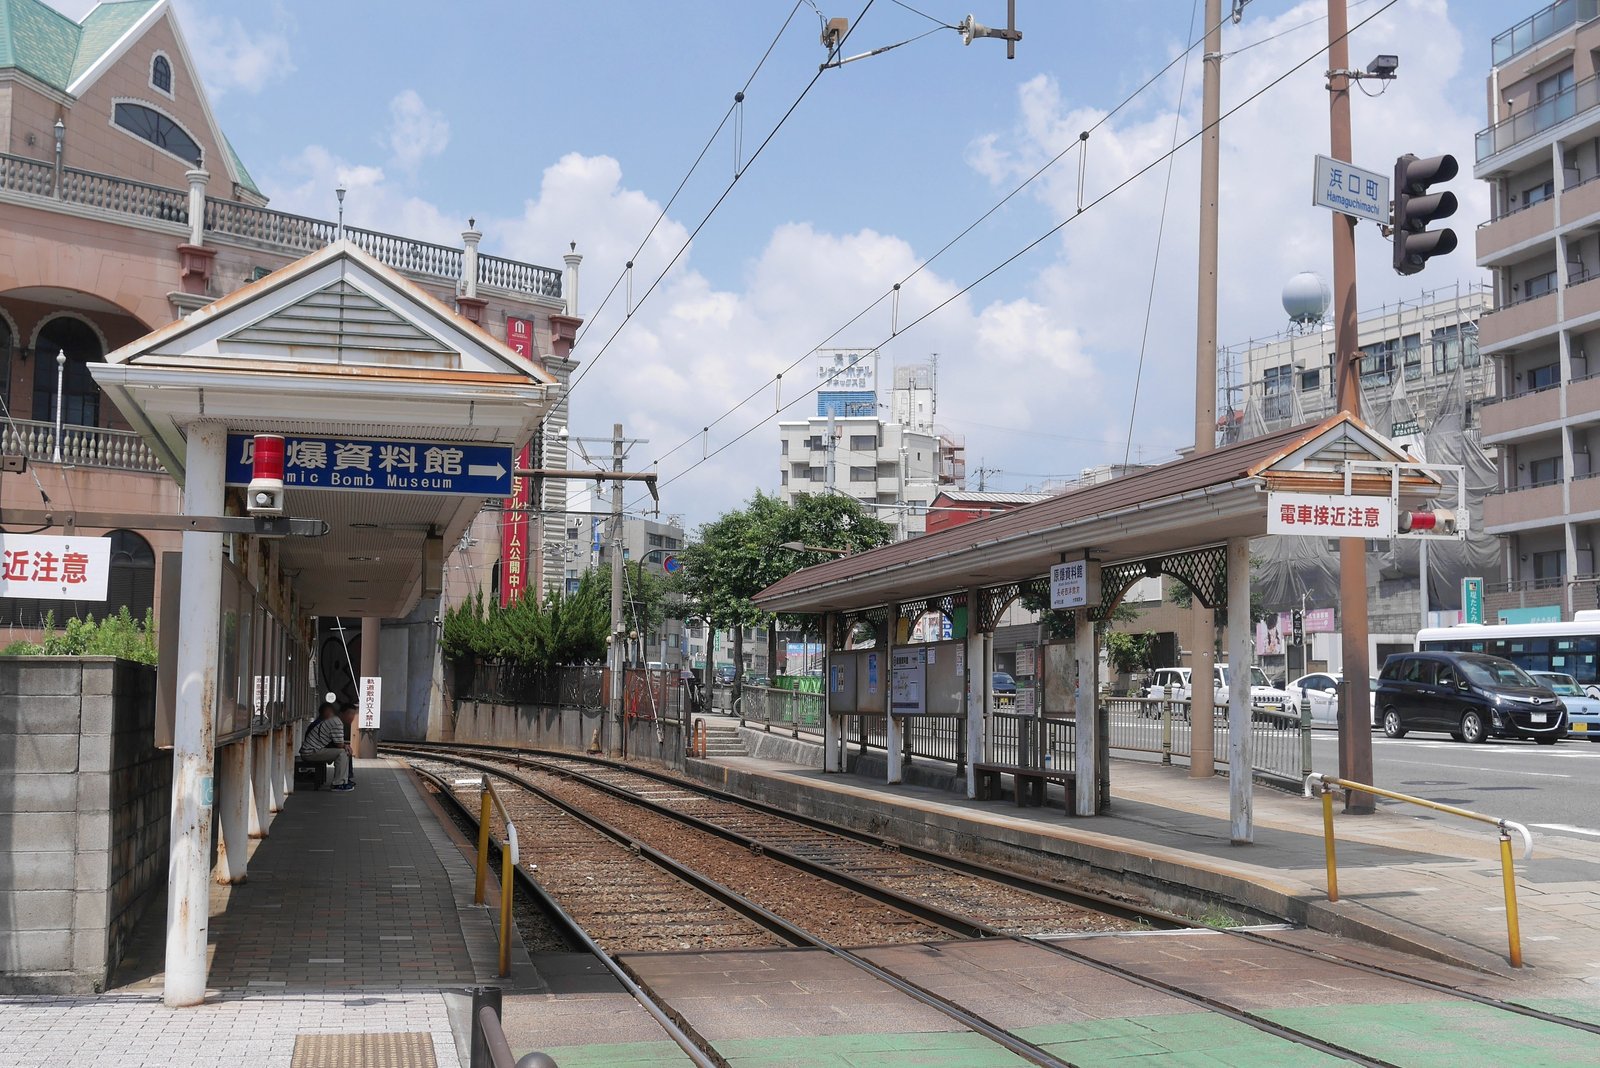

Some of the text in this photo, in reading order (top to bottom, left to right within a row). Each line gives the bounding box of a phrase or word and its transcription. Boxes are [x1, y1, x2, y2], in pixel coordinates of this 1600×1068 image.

[1329, 167, 1378, 201] 浜口町
[1326, 189, 1380, 215] Hamaguchimachi
[331, 473, 374, 487] Bomb
[387, 476, 453, 489] Museum
[1280, 504, 1380, 528] 電車接近注意
[2, 550, 89, 584] 近注意
